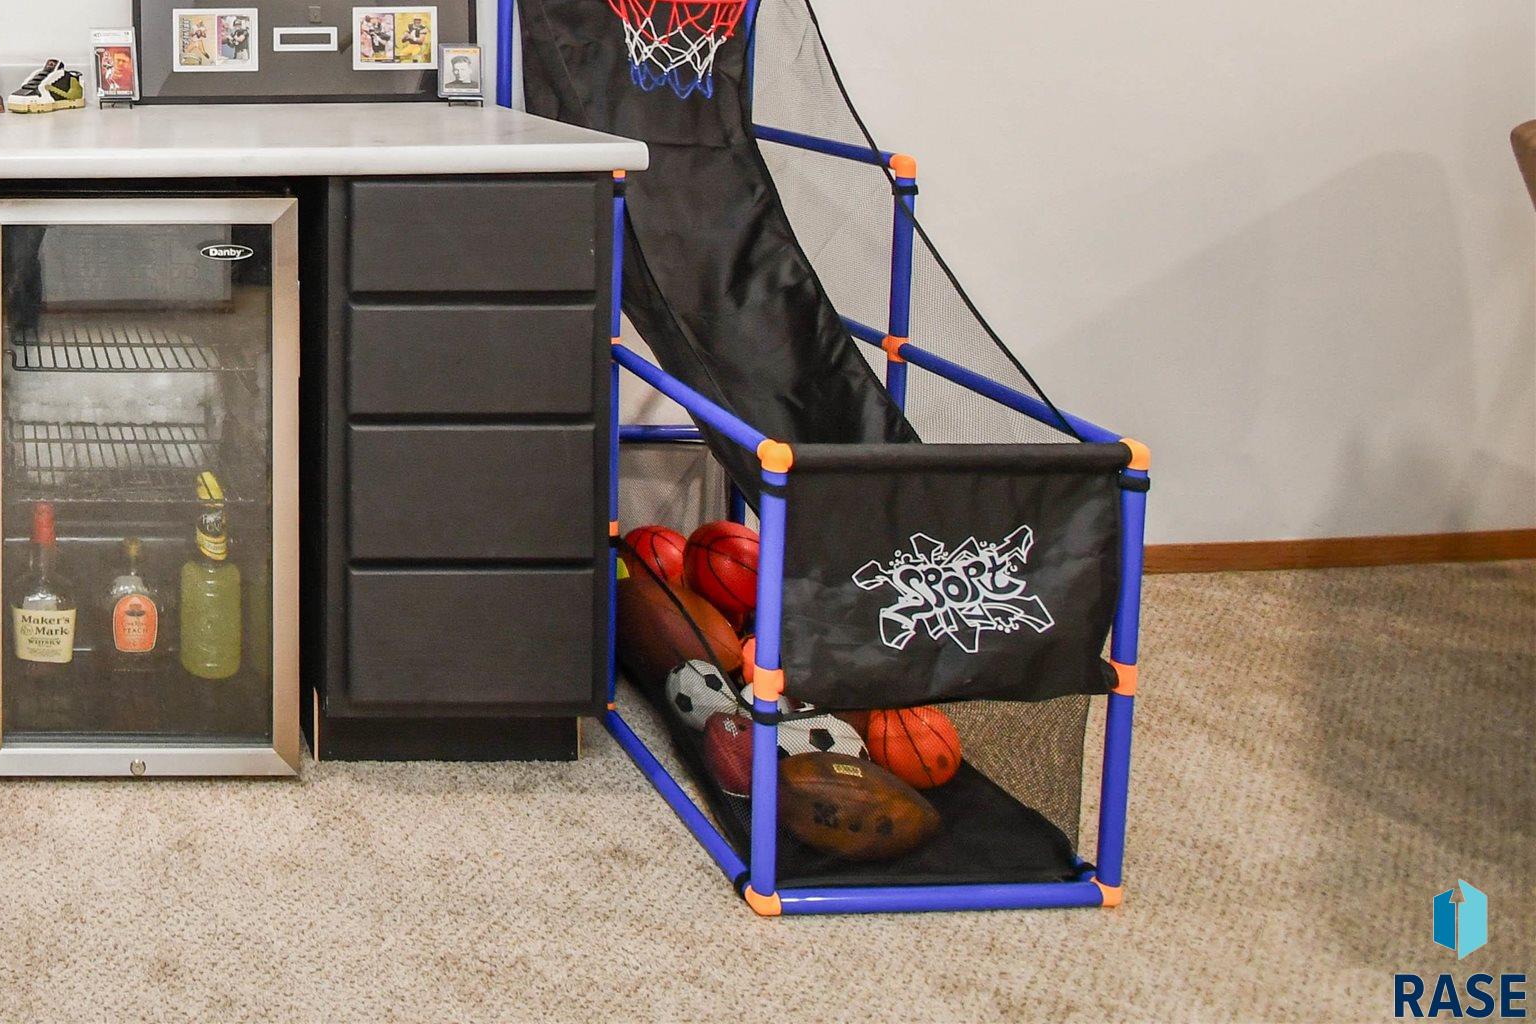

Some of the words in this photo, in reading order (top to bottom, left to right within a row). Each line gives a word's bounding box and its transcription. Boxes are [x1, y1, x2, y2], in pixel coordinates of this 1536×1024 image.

[209, 248, 242, 258] Danby
[21, 615, 70, 625] Maker's
[35, 626, 69, 636] Mark
